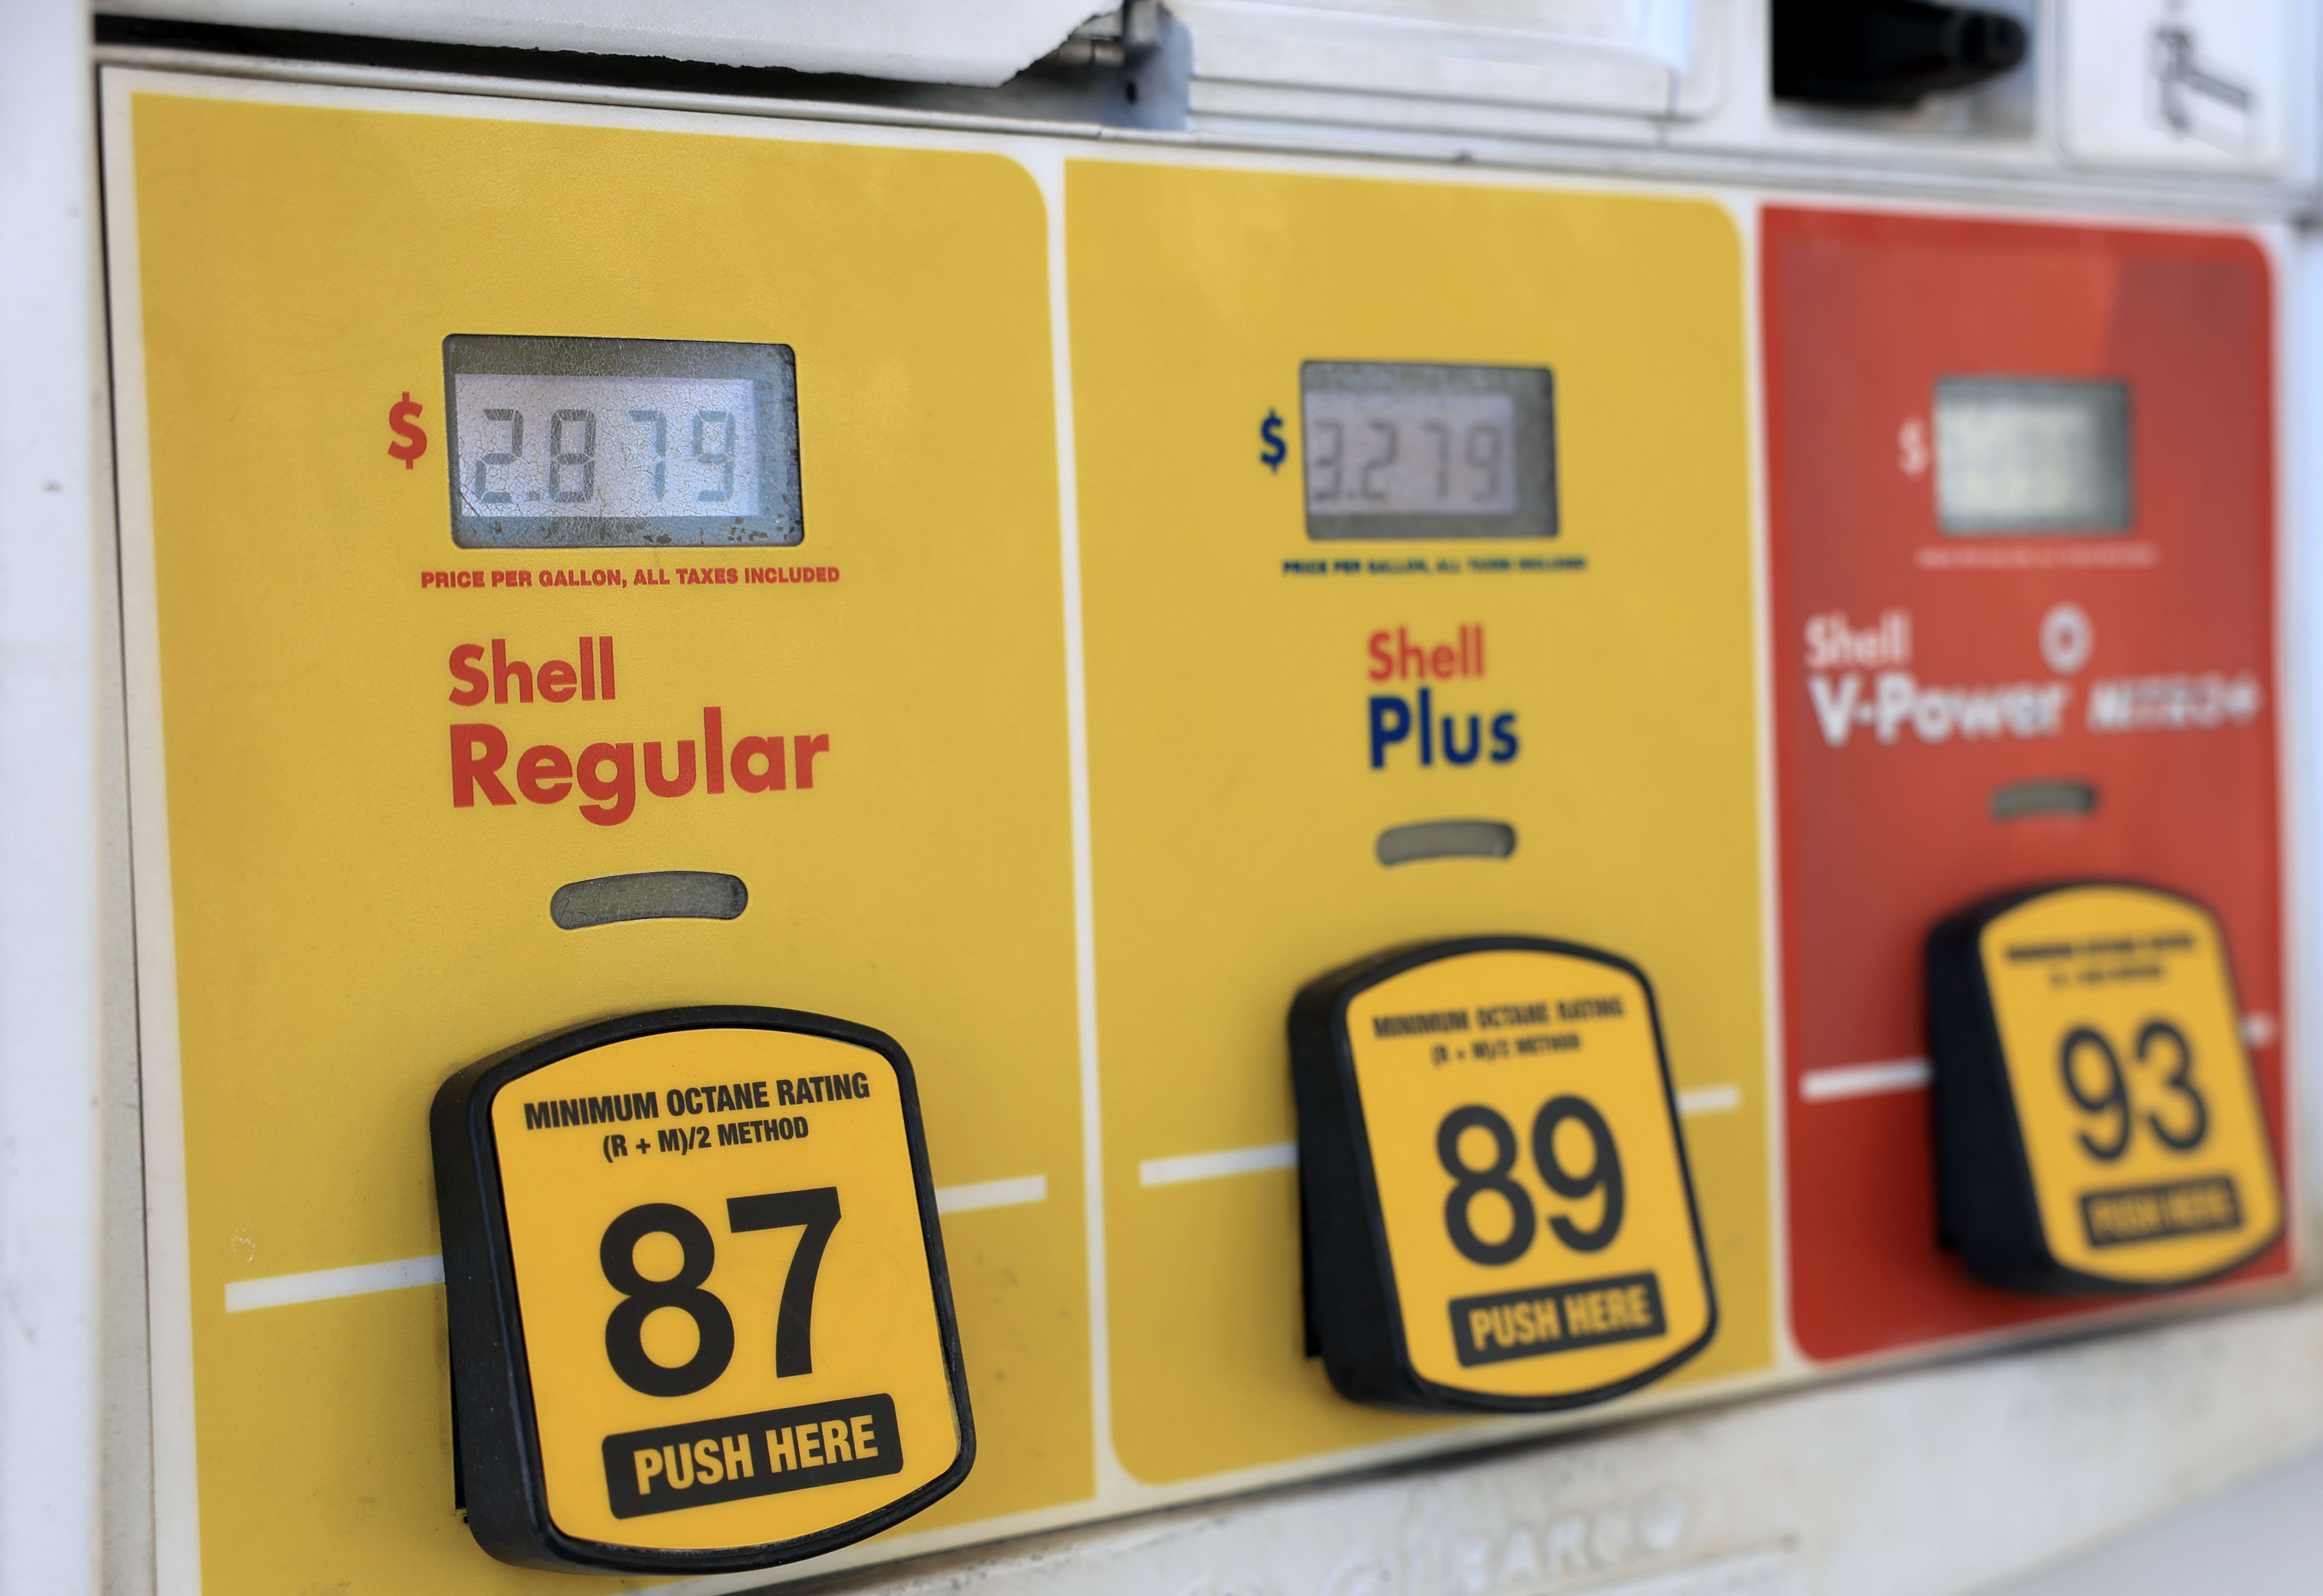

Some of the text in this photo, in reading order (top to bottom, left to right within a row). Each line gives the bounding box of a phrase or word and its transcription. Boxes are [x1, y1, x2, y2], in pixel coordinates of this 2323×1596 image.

[388, 392, 737, 504] $ 2.879
[1260, 407, 1501, 501] $ 3.279
[421, 567, 840, 588] PRICE PER GALLON, ALL TAXES INCLUDED
[448, 636, 616, 706] Shell
[1368, 624, 1485, 683] Shell
[1805, 613, 1910, 668] Shell
[1368, 686, 1520, 770] Plus
[1808, 674, 2068, 748] V-Power
[449, 706, 830, 826] Regular
[524, 1072, 870, 1130] MINIMUM OCTANE RATING
[2062, 1022, 2207, 1160] 93
[603, 1116, 809, 1163] (R + M)/2 METHOD
[1436, 1095, 1624, 1266] 89
[600, 1186, 842, 1398] 87
[1469, 1283, 1652, 1352] PUSH HERE
[634, 1415, 879, 1494] PUSH HERE
